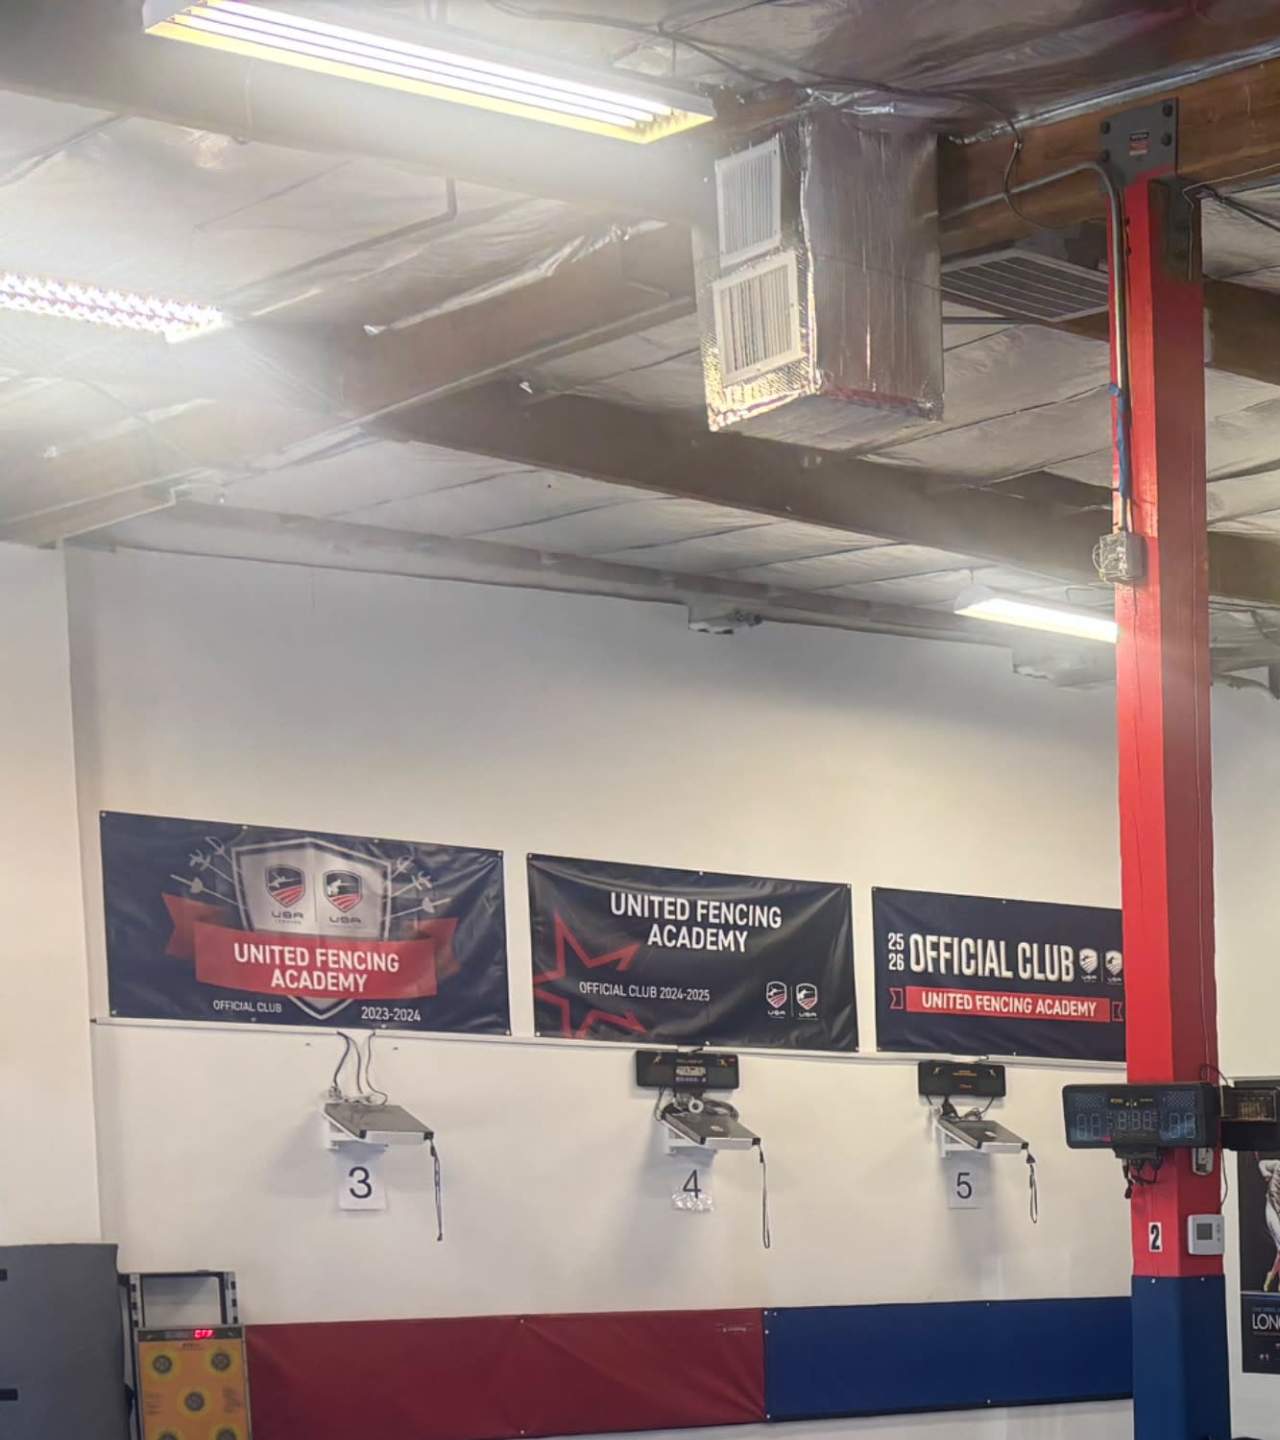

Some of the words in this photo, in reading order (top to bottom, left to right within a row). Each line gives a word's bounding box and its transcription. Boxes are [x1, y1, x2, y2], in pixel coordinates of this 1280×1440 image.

[610, 892, 690, 921] UNITED
[696, 900, 782, 929] FENCING
[648, 923, 748, 953] ACADEMY
[888, 933, 904, 950] 25
[234, 943, 310, 967] UNITED
[316, 950, 400, 973] FENCING
[888, 953, 904, 971] 26
[909, 933, 1014, 980] OFFICIAL
[1017, 941, 1075, 982] CLUB
[271, 969, 368, 993] ACADEMY
[579, 981, 626, 996] OFFICIAL
[628, 985, 658, 998] CLUB
[659, 987, 710, 1001] 2024-2025
[213, 1000, 254, 1012] OFFICIAL
[256, 1003, 282, 1013] CLUB
[361, 1006, 421, 1022] 2023-2024
[921, 990, 973, 1009] UNITED
[975, 995, 1033, 1014] FENCING
[1035, 999, 1097, 1017] ACADEMY
[349, 1166, 372, 1199] 3
[682, 1169, 702, 1200] 4
[957, 1172, 972, 1199] 5
[1151, 1224, 1161, 1250] 2
